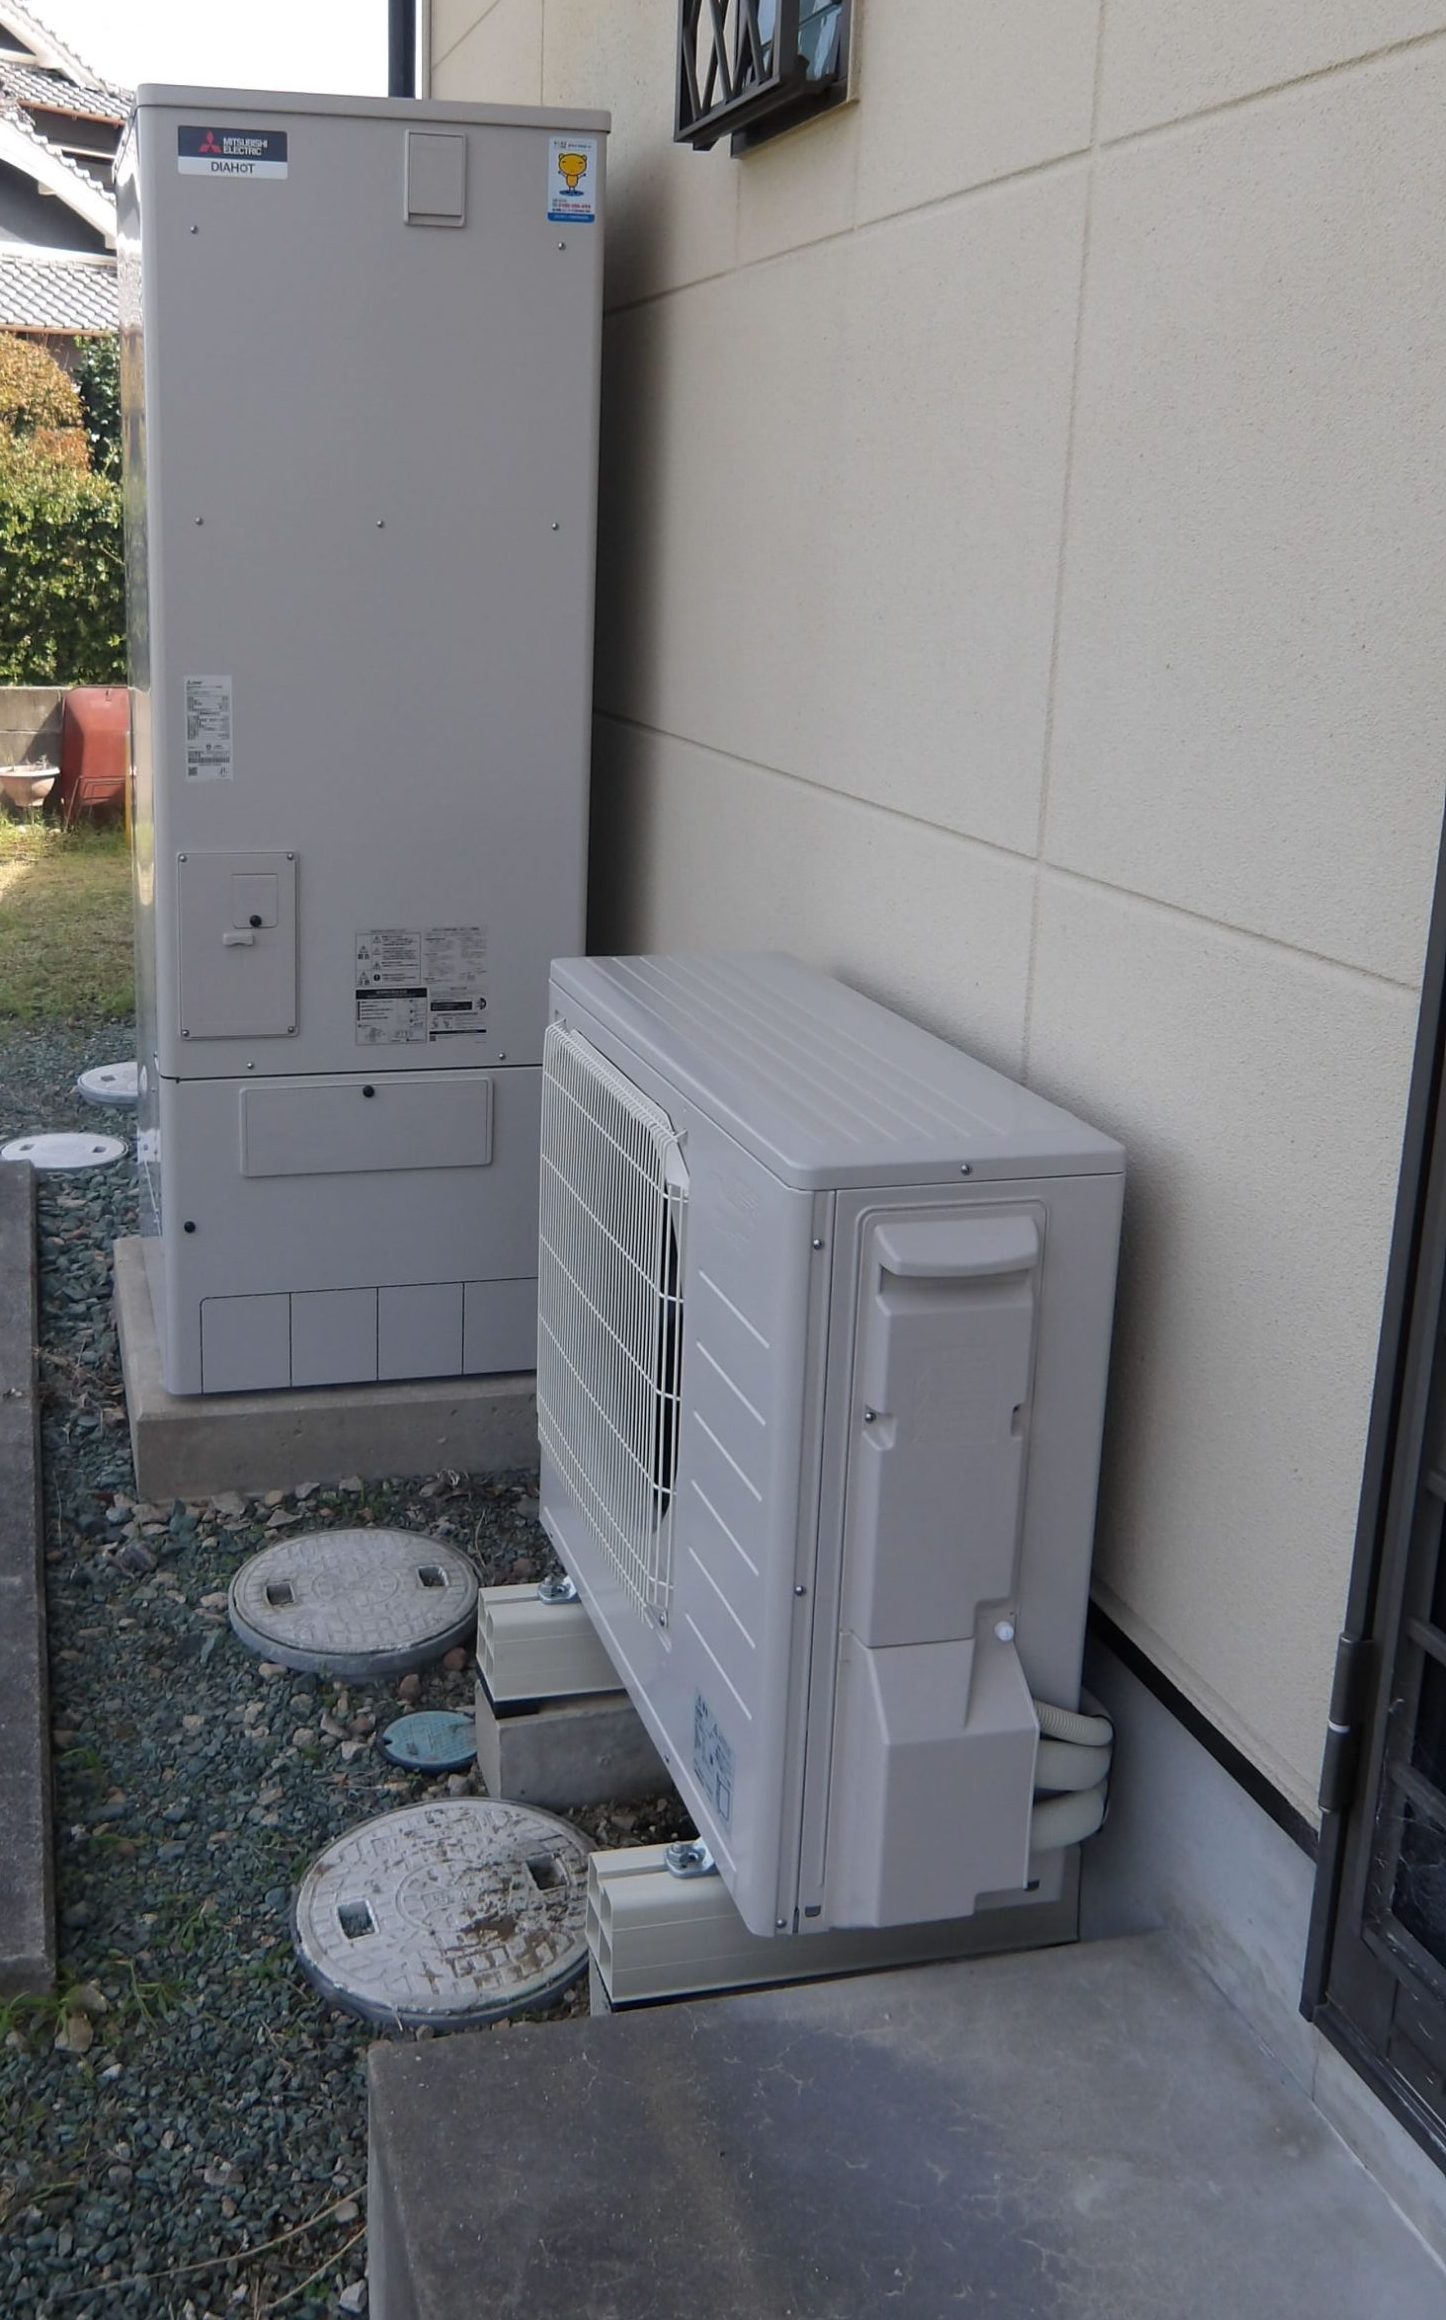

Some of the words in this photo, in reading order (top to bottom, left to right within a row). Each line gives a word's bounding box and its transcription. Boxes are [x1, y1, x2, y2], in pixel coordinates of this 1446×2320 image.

[223, 137, 268, 148] MITSUBISHI
[223, 146, 262, 156] ELECTRIC
[211, 161, 256, 174] DIAHOT
